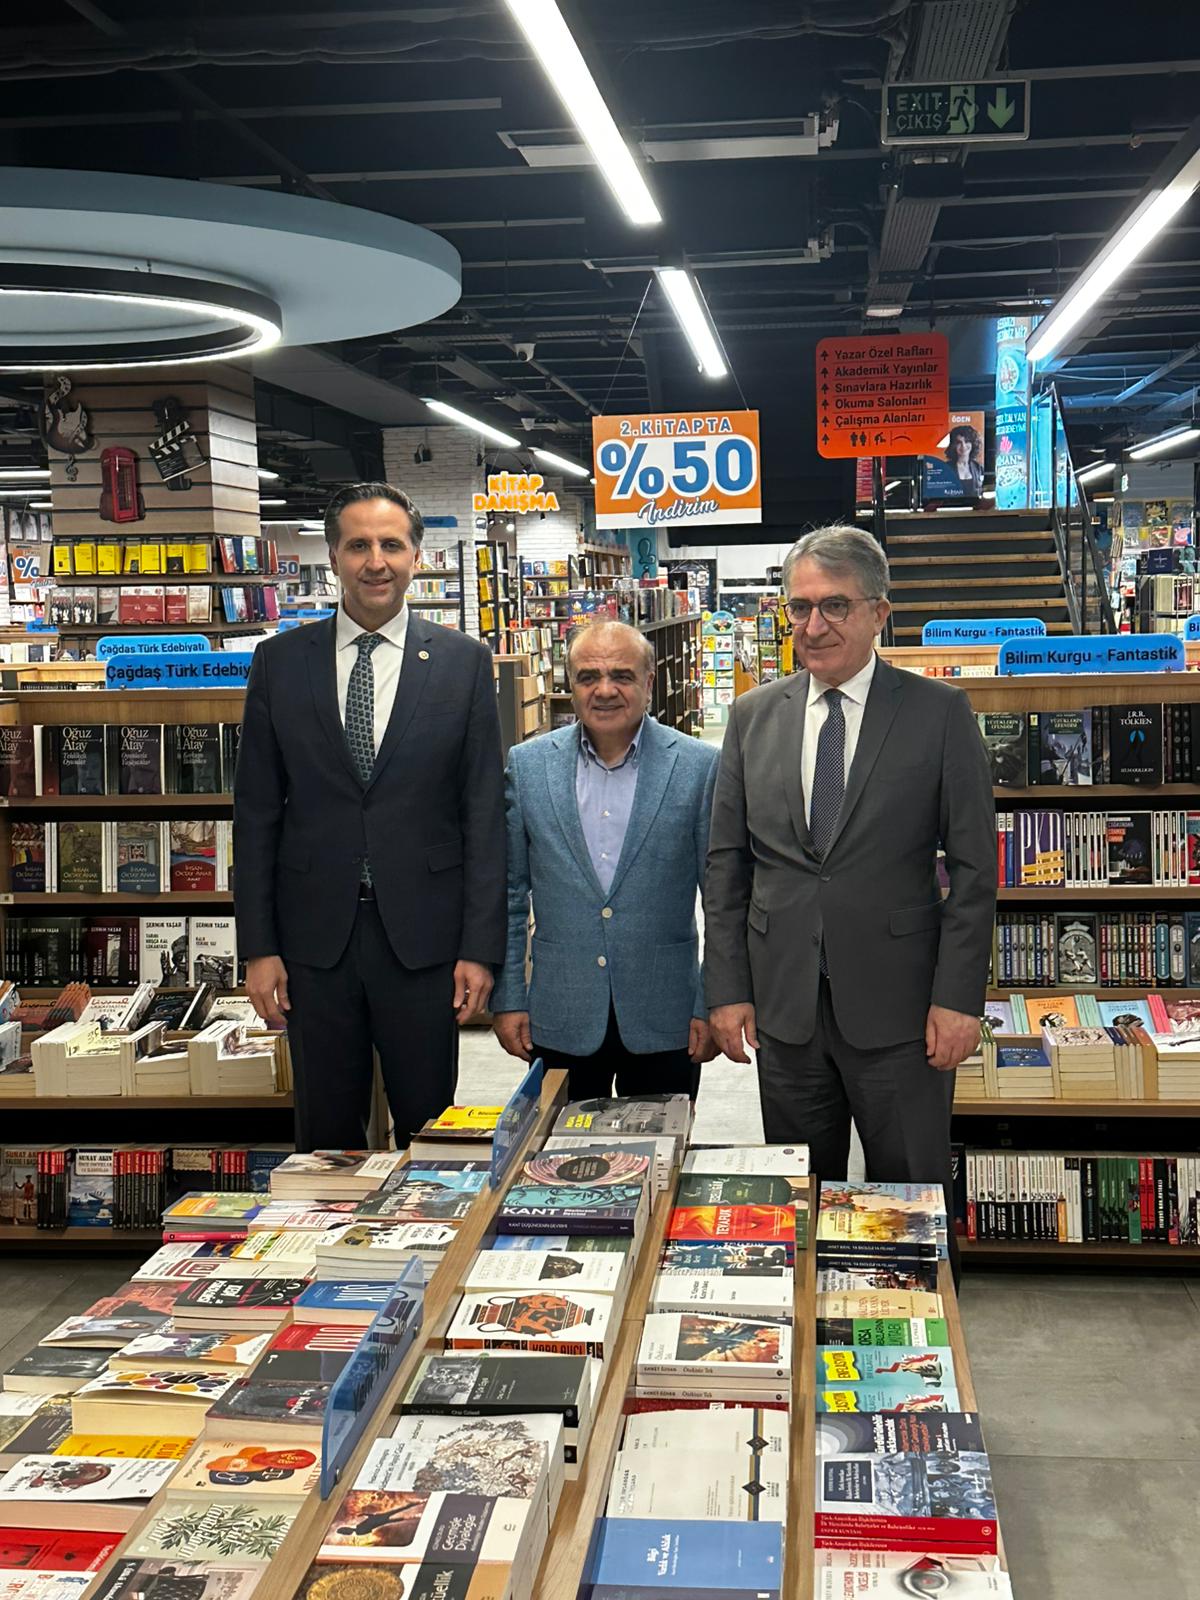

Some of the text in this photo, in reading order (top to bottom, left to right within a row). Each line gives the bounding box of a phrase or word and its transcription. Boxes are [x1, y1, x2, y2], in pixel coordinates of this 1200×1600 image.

[896, 92, 943, 112] EXIT
[896, 113, 942, 132] ÇIKIŞ
[834, 346, 933, 361] Yazar Özel Rafları
[834, 362, 938, 377] Akademik Yayınlar
[835, 379, 932, 393] Sınavlara Hazırlık
[835, 396, 926, 409] Okuma Salonları
[835, 412, 925, 428] Çalışma Alanları
[600, 438, 754, 498] %50
[487, 471, 545, 494] KİTAP
[472, 491, 559, 514] DANIŞMA
[638, 496, 719, 525] İndirim
[925, 627, 951, 638] Bilim
[954, 626, 986, 640] Kurgu
[995, 626, 1044, 637] Fantastik
[138, 643, 159, 653] Türk
[161, 642, 204, 653] Edebiyatı
[1005, 651, 1042, 665] Bilim
[1047, 650, 1091, 666] Kurgu
[1107, 646, 1177, 661] Fantastik
[106, 664, 161, 682] Çağdaş
[165, 663, 198, 678] Türk
[1120, 717, 1152, 725] TOLKIEN
[1128, 710, 1146, 718] J.R.R.
[62, 726, 92, 740] Oğuz
[121, 726, 149, 740] Oğuz
[182, 725, 208, 740] Oğuz
[62, 738, 88, 753] Atay
[121, 738, 145, 752] Atay
[182, 738, 205, 752] Atay
[502, 1207, 560, 1216] KANT
[716, 1208, 733, 1236] TEVAFUK
[858, 1328, 872, 1345] ORSA
[872, 1414, 884, 1454] ürdürülebilir
[886, 1418, 897, 1454] eklamcılık
